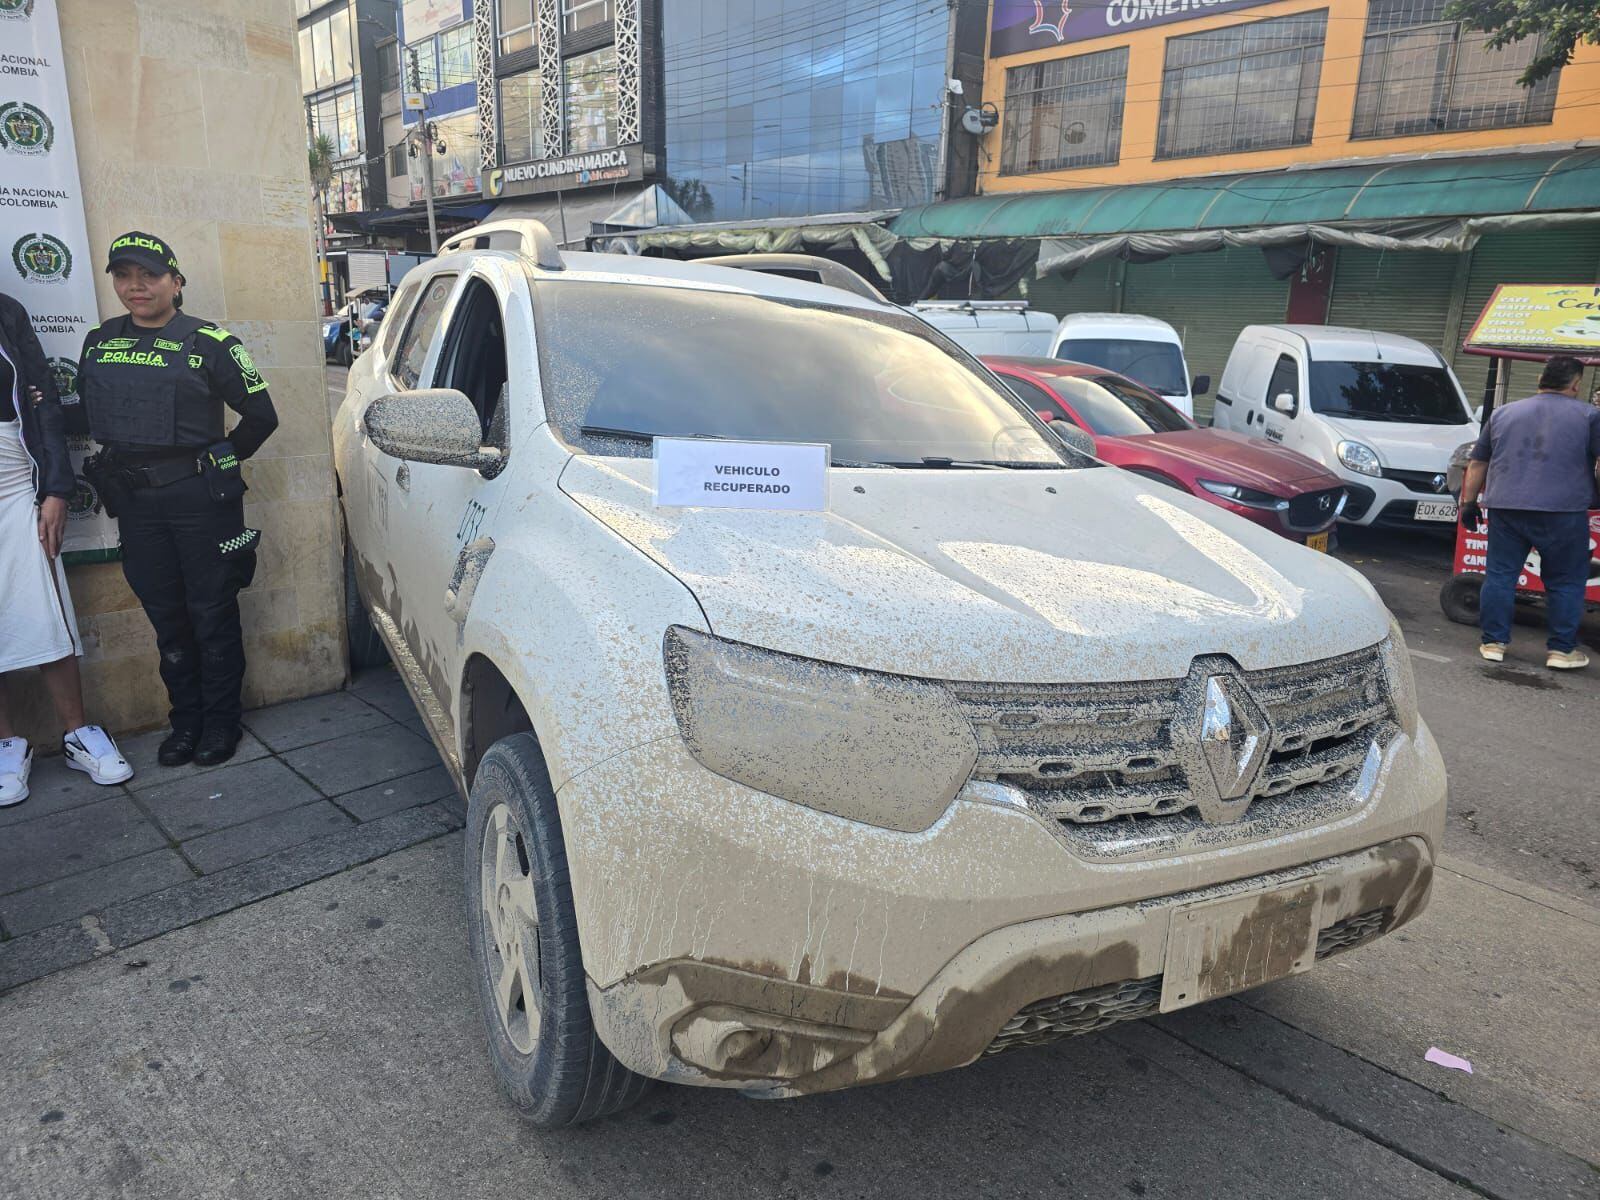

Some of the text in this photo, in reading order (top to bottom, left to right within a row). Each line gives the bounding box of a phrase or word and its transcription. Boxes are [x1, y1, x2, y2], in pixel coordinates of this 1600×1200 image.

[0, 65, 39, 77] OMBIA
[504, 150, 628, 183] NUEVO CUNDINAMARCA
[12, 187, 70, 199] NACIONAL
[0, 198, 58, 209] COLOMBIA
[31, 315, 86, 323] NACIONAL
[715, 465, 780, 477] VEHICULO
[704, 481, 791, 494] RECUPERADO
[1439, 504, 1457, 517] 628
